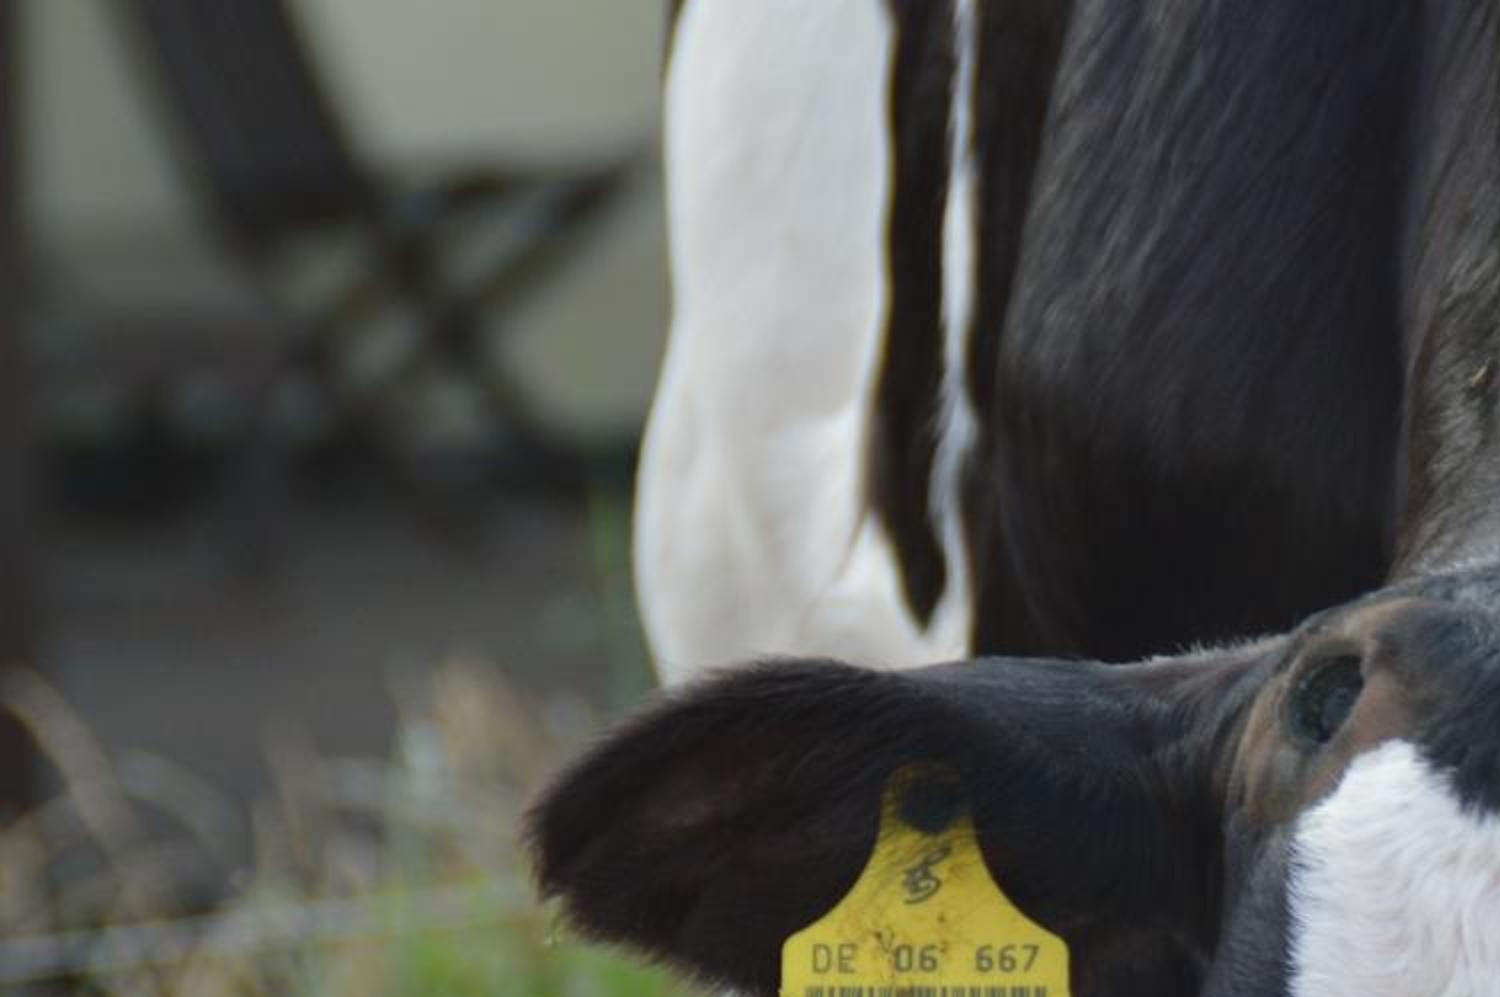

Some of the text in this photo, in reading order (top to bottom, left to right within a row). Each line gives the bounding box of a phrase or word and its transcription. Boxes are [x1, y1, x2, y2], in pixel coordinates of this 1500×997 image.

[812, 943, 1041, 973] DE 06 667
